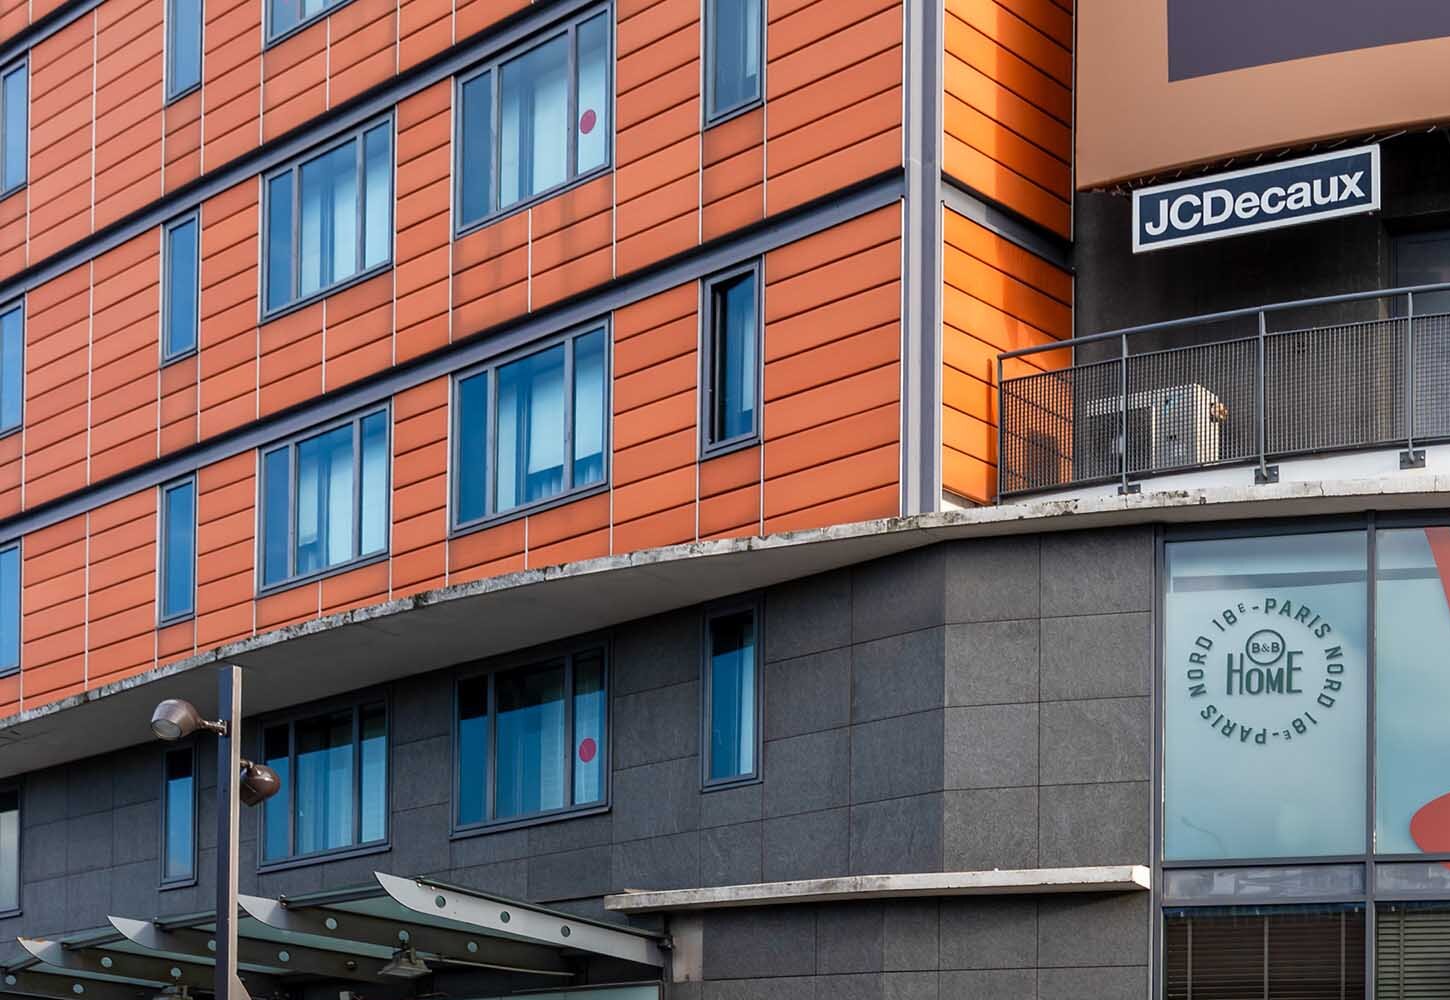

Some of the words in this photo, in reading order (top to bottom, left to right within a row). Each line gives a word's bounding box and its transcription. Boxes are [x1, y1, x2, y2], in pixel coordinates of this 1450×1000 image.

[1145, 171, 1366, 236] JCDecaux
[1187, 635, 1213, 697] NORD
[1226, 650, 1303, 695] HOME
[1251, 641, 1280, 654] B&B
[1263, 598, 1332, 639] PARIS
[1317, 645, 1345, 708] NORD
[1200, 704, 1267, 745] PARIS
